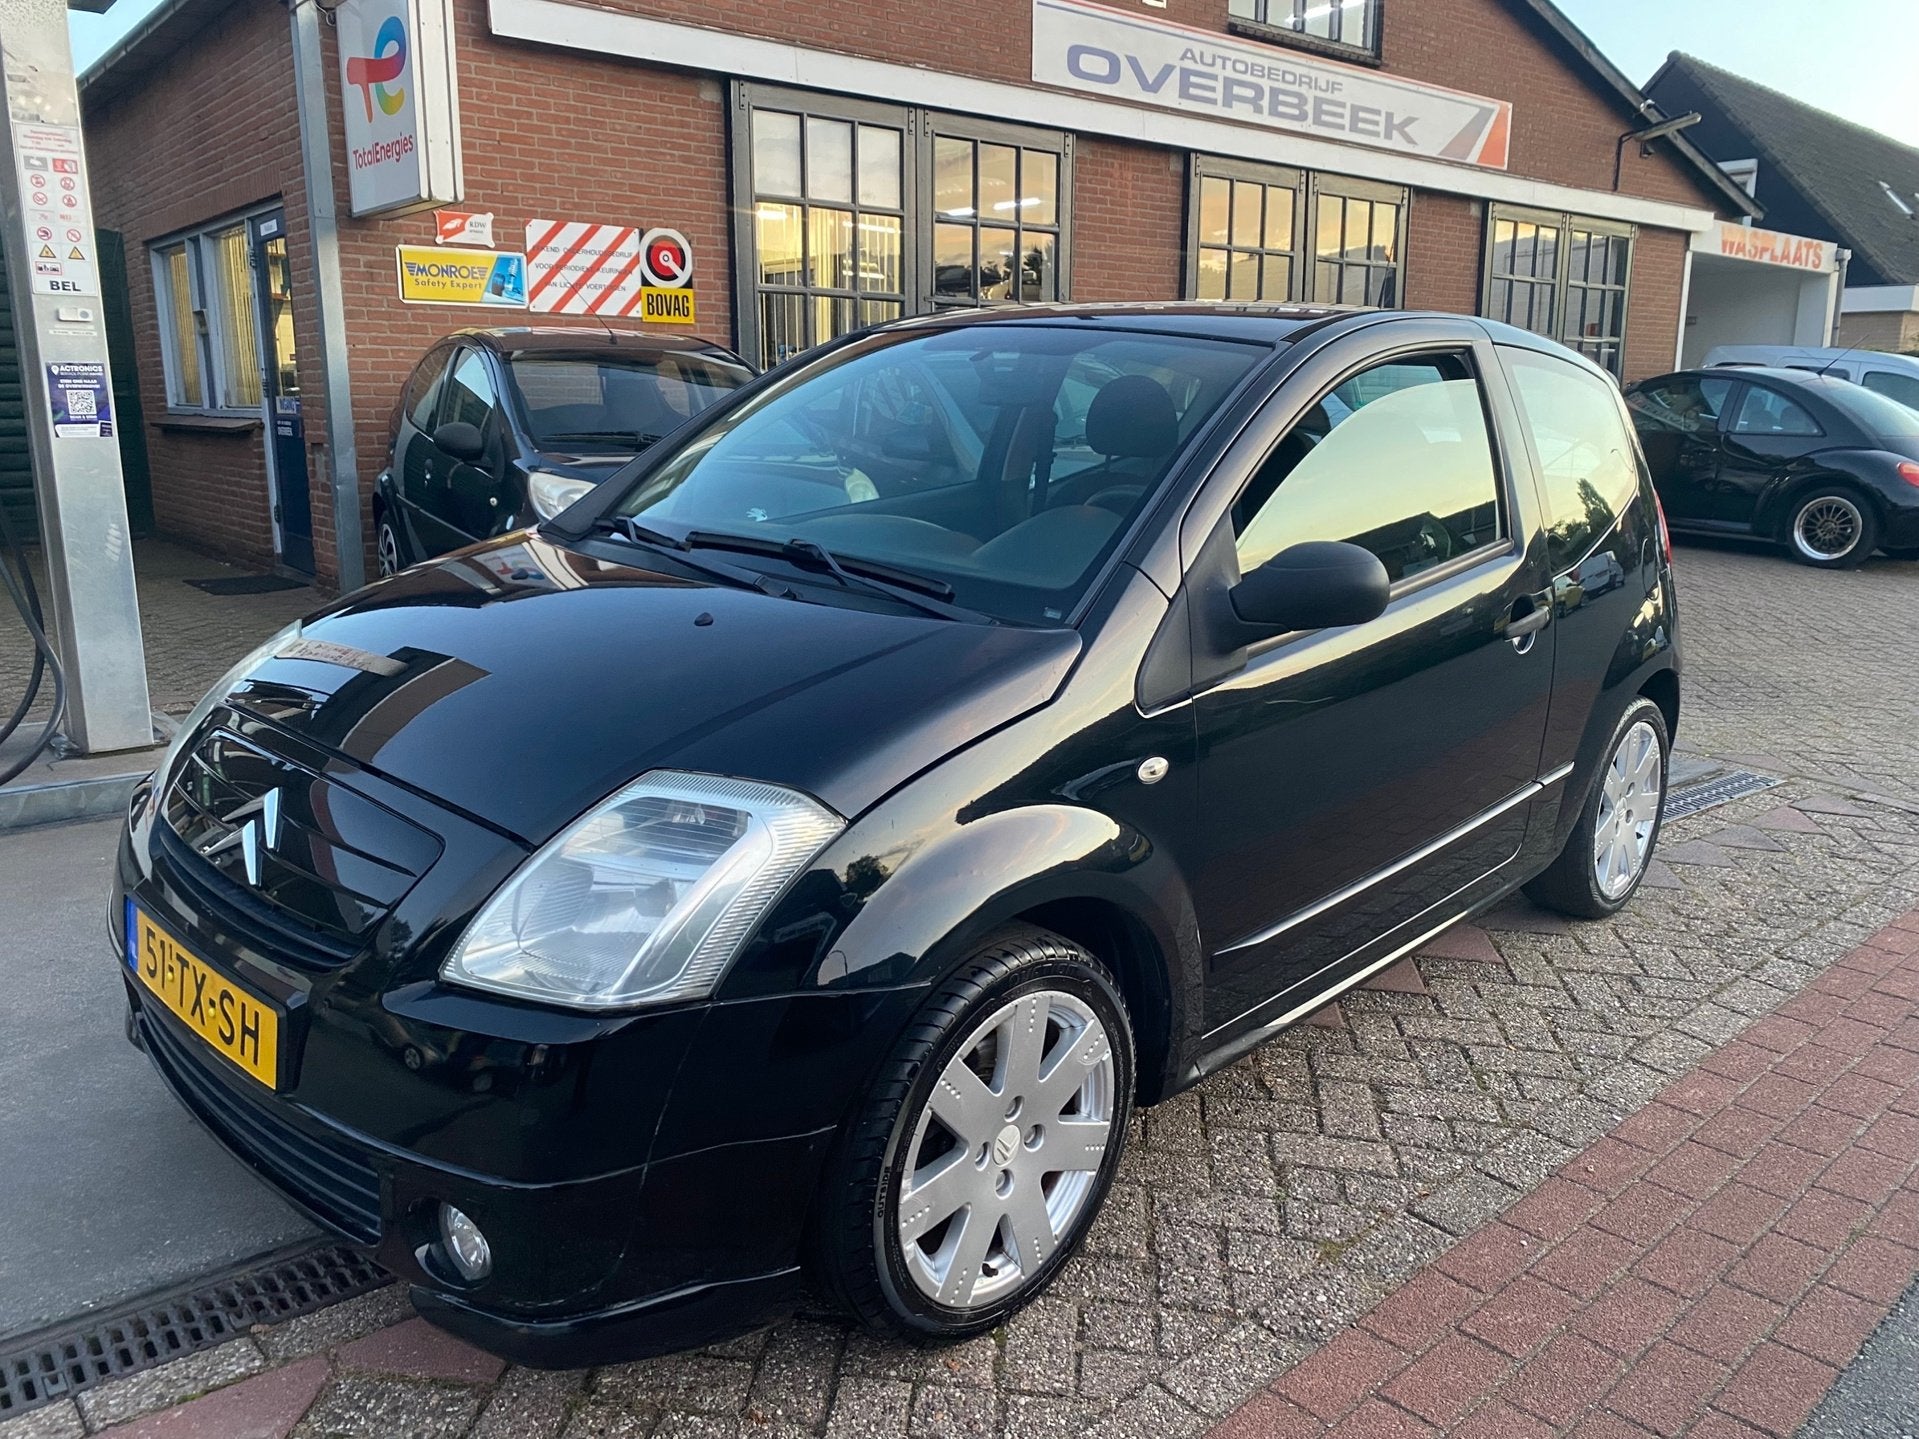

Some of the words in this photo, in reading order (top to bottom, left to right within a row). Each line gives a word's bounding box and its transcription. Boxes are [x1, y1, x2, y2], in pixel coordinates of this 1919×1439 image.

[1179, 47, 1344, 97] AUTOBEDRIJF
[1066, 44, 1423, 146] OVERBEEK
[353, 131, 414, 170] TotalEnergies
[1720, 225, 1824, 270] WASPLAATS
[49, 280, 82, 292] BEL
[414, 279, 447, 289] Safety
[450, 280, 482, 290] Expert
[415, 263, 479, 280] MONROE
[646, 293, 690, 317] BOVAG
[146, 924, 260, 1067] 51-TX-SH
